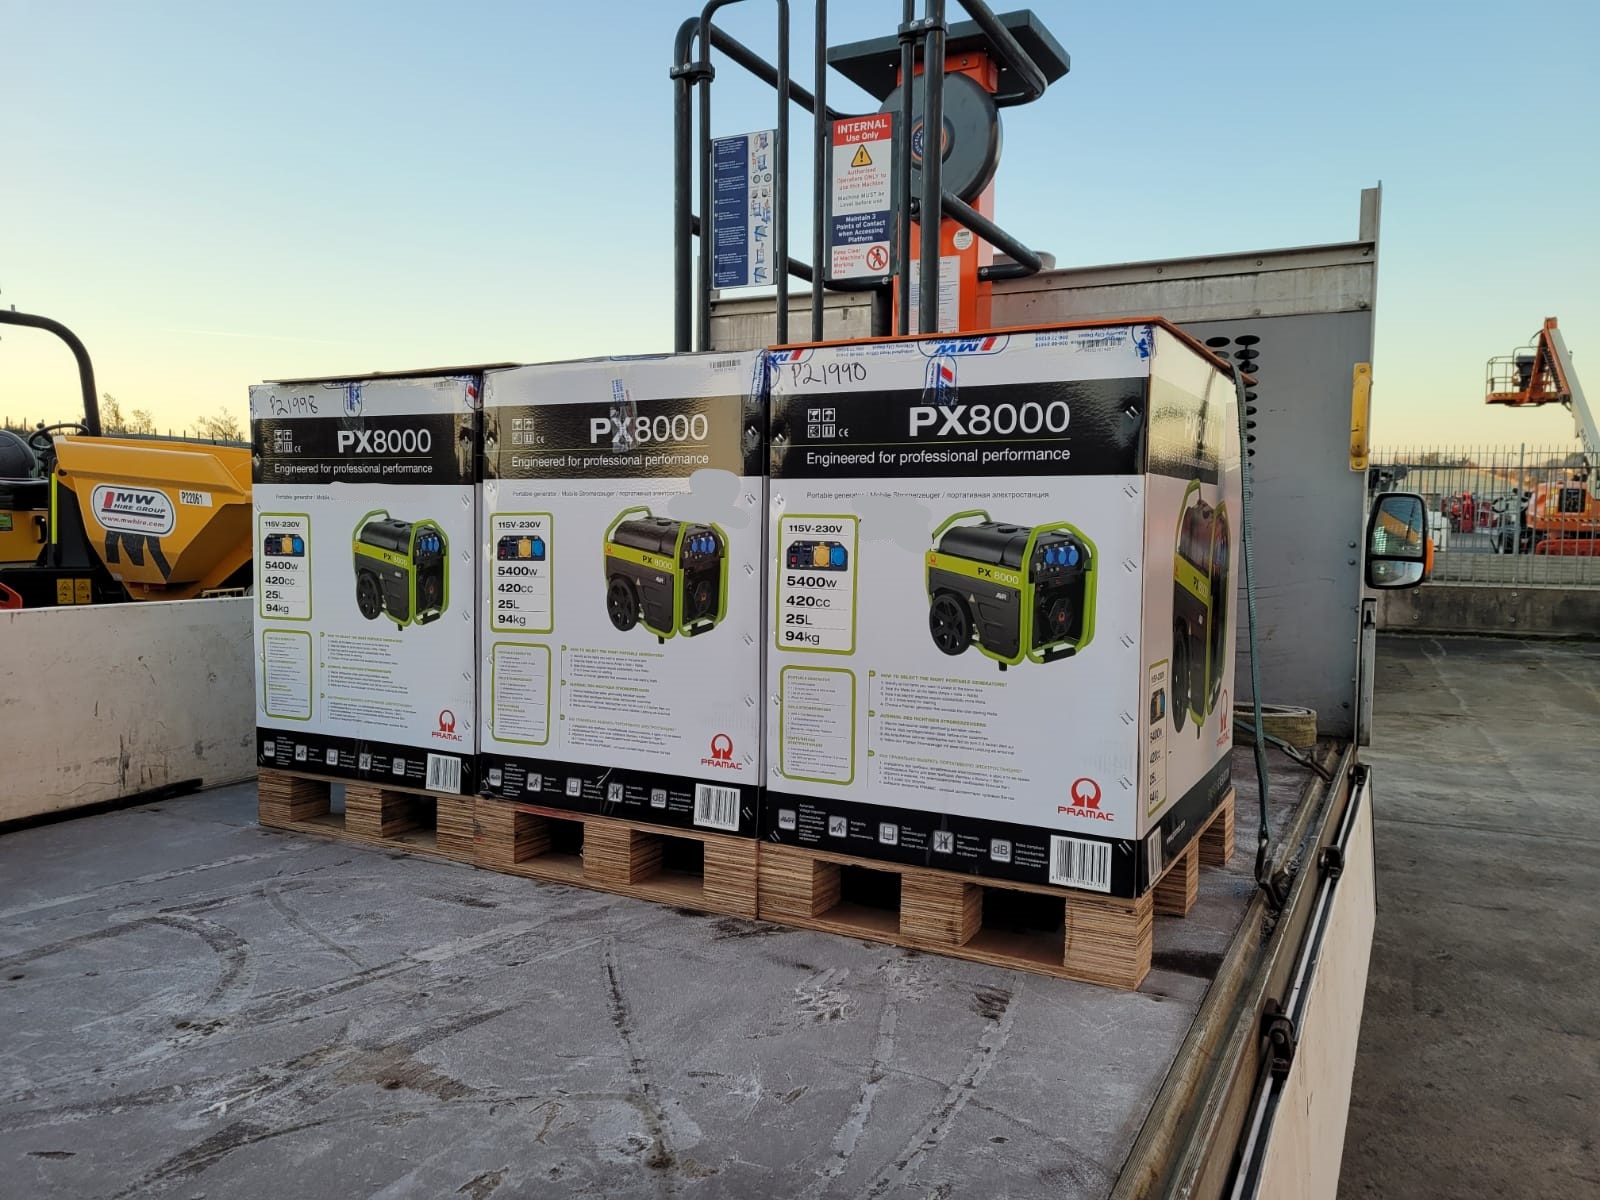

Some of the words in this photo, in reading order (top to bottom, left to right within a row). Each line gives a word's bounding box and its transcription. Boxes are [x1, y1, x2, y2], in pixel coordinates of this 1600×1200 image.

[838, 119, 888, 135] INTERNAL
[846, 134, 860, 142] Use
[861, 131, 879, 140] Only
[861, 191, 878, 199] MUST
[846, 213, 870, 222] Maintain
[836, 223, 855, 231] Points
[862, 219, 886, 228] Contact
[854, 227, 884, 236] Accessing
[848, 235, 873, 243] Platform
[934, 343, 979, 354] MW
[269, 395, 318, 416] P21998
[909, 401, 1070, 437] PX8000
[590, 414, 708, 444] PX8000
[337, 428, 432, 454] PX8000
[512, 455, 564, 470] Engineered
[568, 455, 580, 467] for
[583, 453, 642, 468] professional
[645, 452, 709, 467] performance
[806, 452, 875, 468] Engineered
[878, 451, 896, 464] for
[899, 449, 978, 466] professional
[982, 448, 1071, 466] performance
[274, 463, 318, 478] Engineered
[320, 463, 332, 474] for
[333, 462, 380, 476] professional
[382, 462, 433, 476] performance
[116, 492, 155, 505] MW
[806, 491, 833, 499] Portable
[136, 504, 165, 514] GROUP
[102, 515, 165, 529] www.mwhire.com
[265, 521, 300, 529] 115V-230V
[498, 521, 541, 529] 115V-230V
[789, 525, 843, 534] 115V-230V
[642, 555, 652, 565] PX
[265, 576, 295, 585] 420cc
[978, 567, 992, 579] PX
[994, 571, 1019, 585] 8000
[498, 584, 534, 594] 420cc
[265, 591, 283, 599] 25L
[498, 600, 520, 610] 25L
[786, 596, 831, 608] 420cc
[266, 604, 289, 615] 94kg
[498, 615, 526, 627] 94kg
[785, 614, 813, 625] 25L
[785, 630, 820, 645] 94kg
[432, 731, 462, 742] PRAMAC
[701, 758, 742, 771] PRAMAC
[1057, 805, 1115, 822] PRAMAC
[992, 844, 1008, 856] dB
